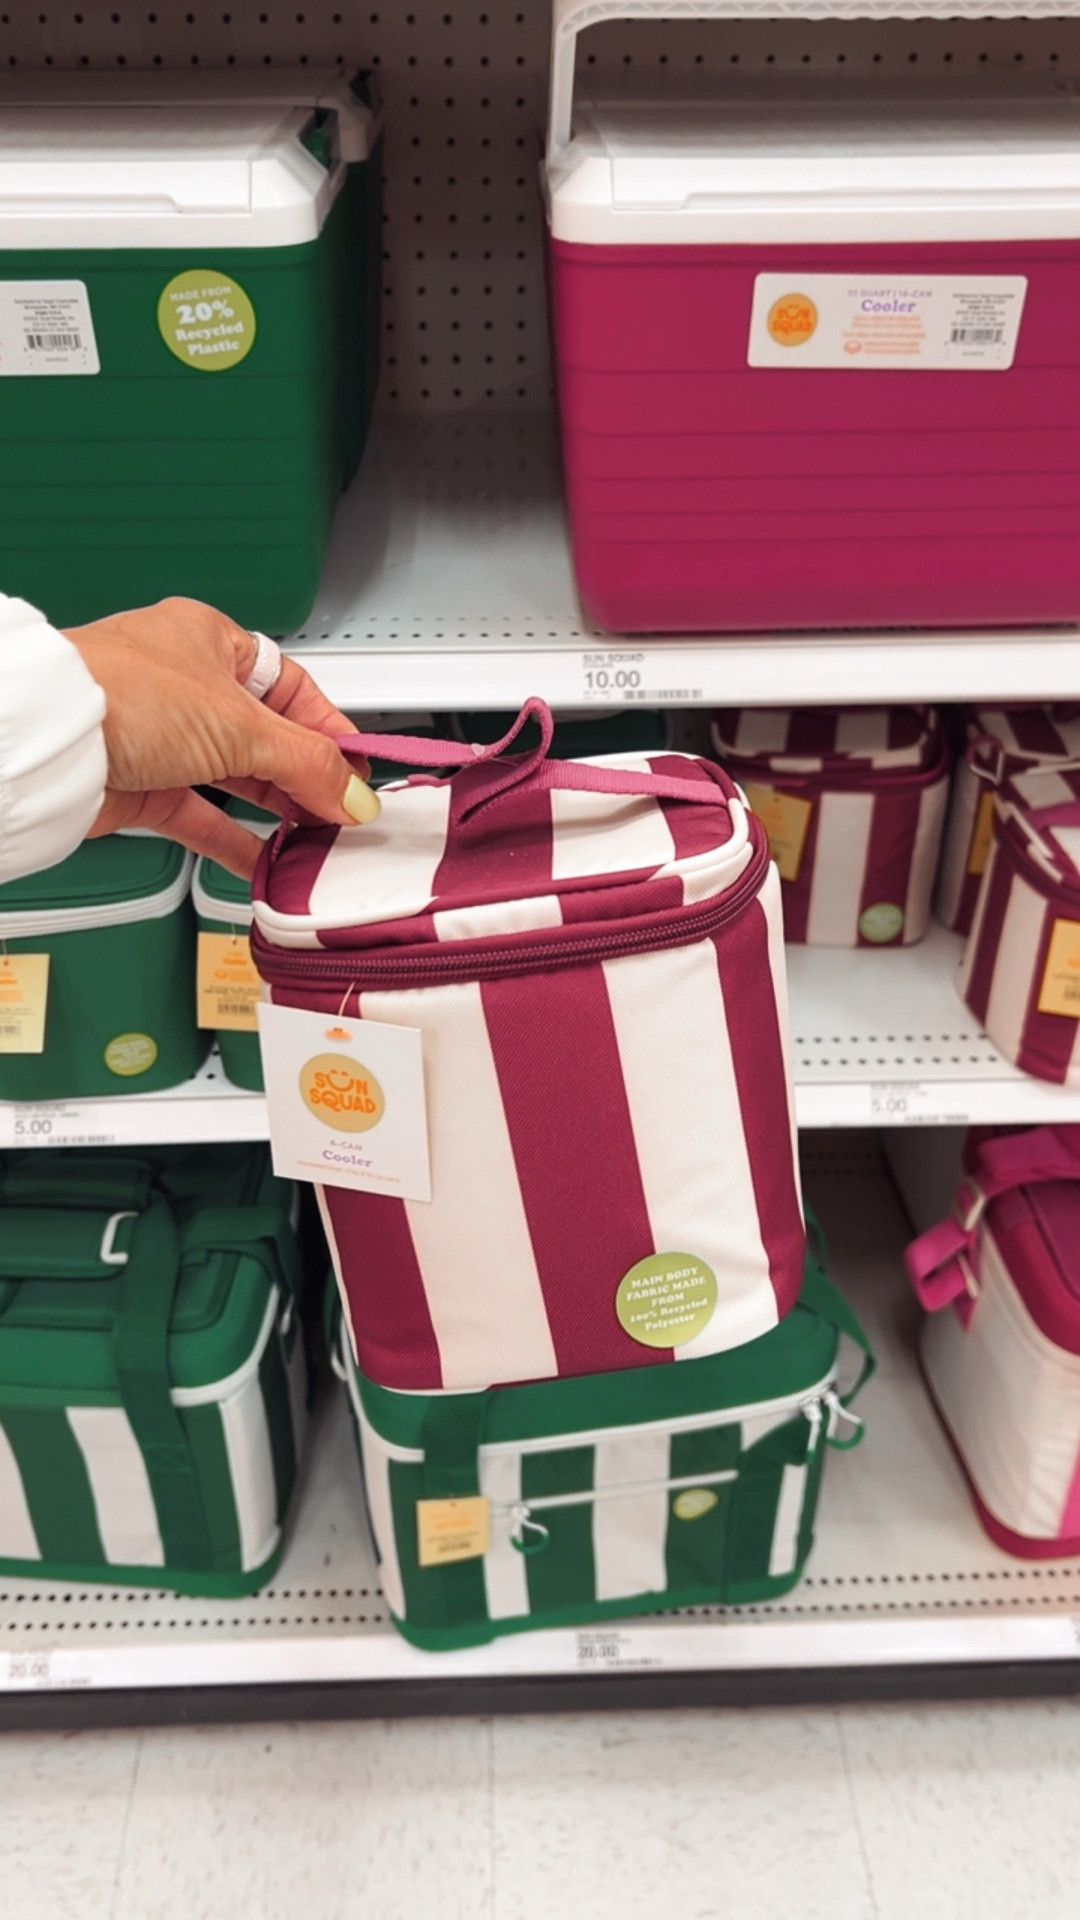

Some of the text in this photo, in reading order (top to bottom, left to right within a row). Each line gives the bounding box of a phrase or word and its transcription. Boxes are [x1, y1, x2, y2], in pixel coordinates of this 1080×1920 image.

[169, 285, 232, 301] MADE FROM
[176, 299, 234, 325] 20%
[776, 307, 811, 320] SUN
[861, 299, 916, 312] Cooler
[175, 321, 244, 341] Recycled
[772, 320, 812, 335] SQUAD
[187, 340, 239, 356] Plastic
[584, 670, 641, 689] 10.00
[315, 1070, 368, 1096] SUN
[309, 1088, 376, 1114] SQUAD
[871, 1098, 907, 1113] 5.00
[15, 1119, 52, 1135] 5.00
[322, 1150, 373, 1167] Cooler
[631, 1266, 699, 1289] MAIN BODY
[626, 1276, 706, 1301] FABRIC MADE
[652, 1292, 685, 1307] FROM
[630, 1298, 708, 1323] 100% Recycled
[644, 1313, 696, 1331] Polyester
